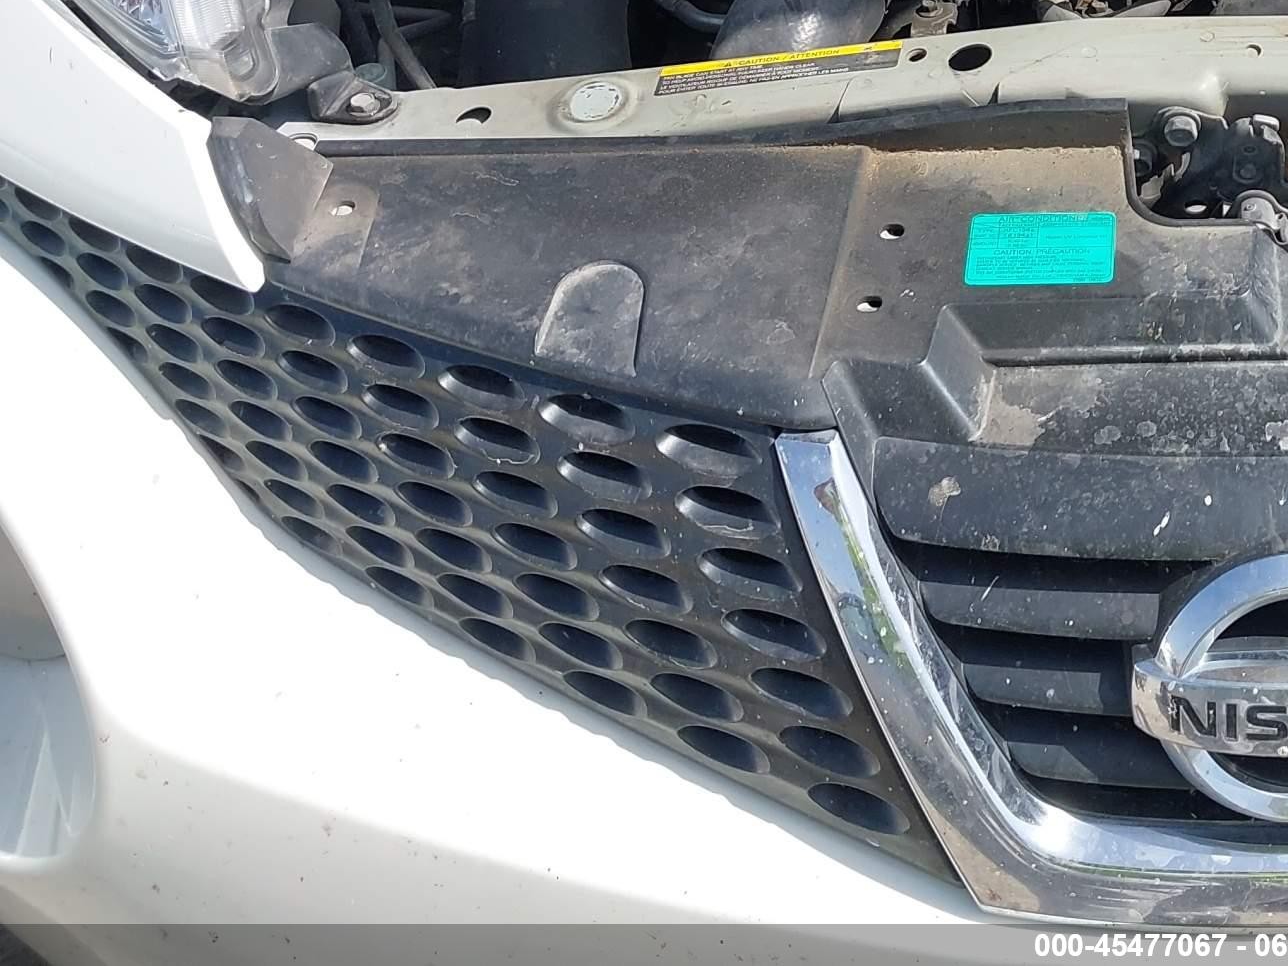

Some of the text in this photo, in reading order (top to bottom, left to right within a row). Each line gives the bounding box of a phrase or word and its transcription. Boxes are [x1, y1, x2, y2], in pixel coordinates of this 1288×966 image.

[738, 56, 778, 66] CAUTION
[789, 50, 840, 59] ATTENTION
[993, 248, 1032, 256] CAUTION
